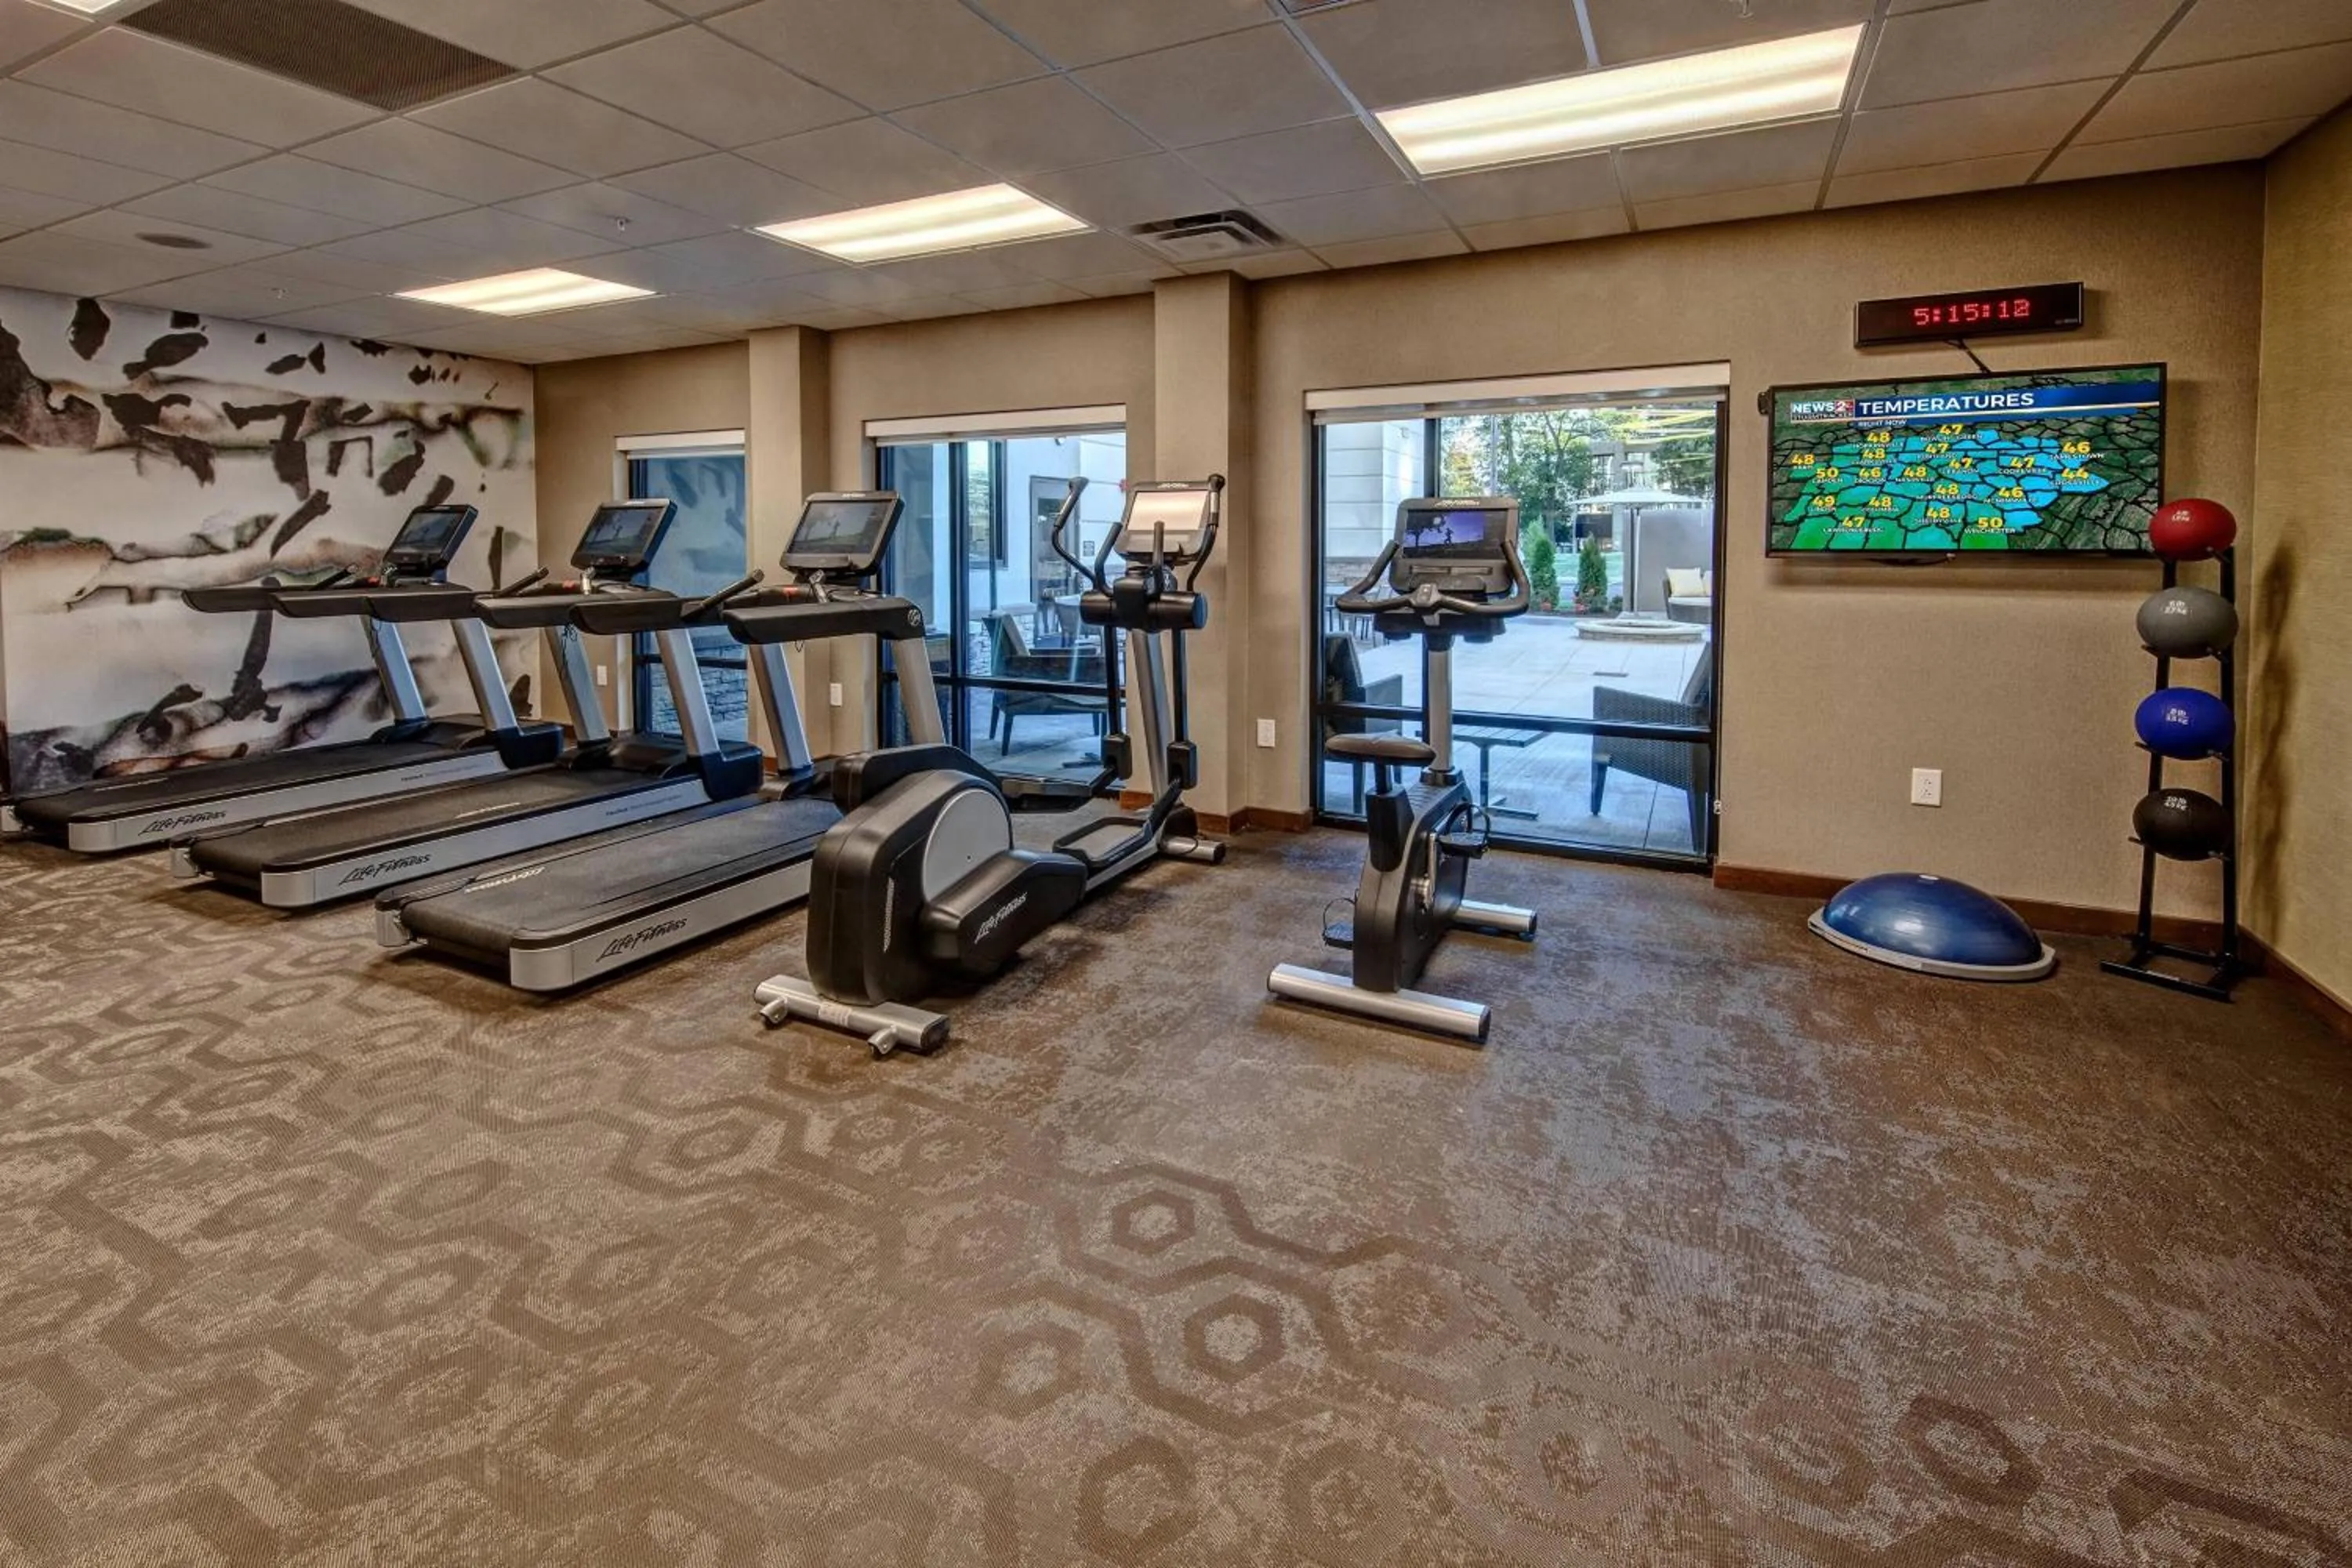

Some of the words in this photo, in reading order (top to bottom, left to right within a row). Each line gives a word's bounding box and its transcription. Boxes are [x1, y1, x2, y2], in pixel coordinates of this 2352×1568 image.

[1792, 401, 1835, 414] NEWS
[1859, 393, 2034, 415] TEMPERATURES
[1940, 424, 1964, 435] 47
[1867, 431, 1891, 444] 48
[1862, 448, 1886, 459] 48
[1926, 443, 1950, 454] 47
[2063, 441, 2091, 454] 46
[1791, 453, 1815, 466] 48
[1950, 457, 1973, 469] 47
[2010, 456, 2035, 468] 47
[1816, 467, 1839, 478] 50
[1859, 466, 1882, 478] 46
[1904, 466, 1927, 477] 48
[1936, 484, 1959, 495] 48
[1999, 487, 2024, 498] 46
[1813, 495, 1835, 507] 49
[1869, 496, 1893, 508] 48
[1927, 507, 1951, 518] 48
[1843, 516, 1866, 528] 47
[1978, 517, 2003, 528] 50
